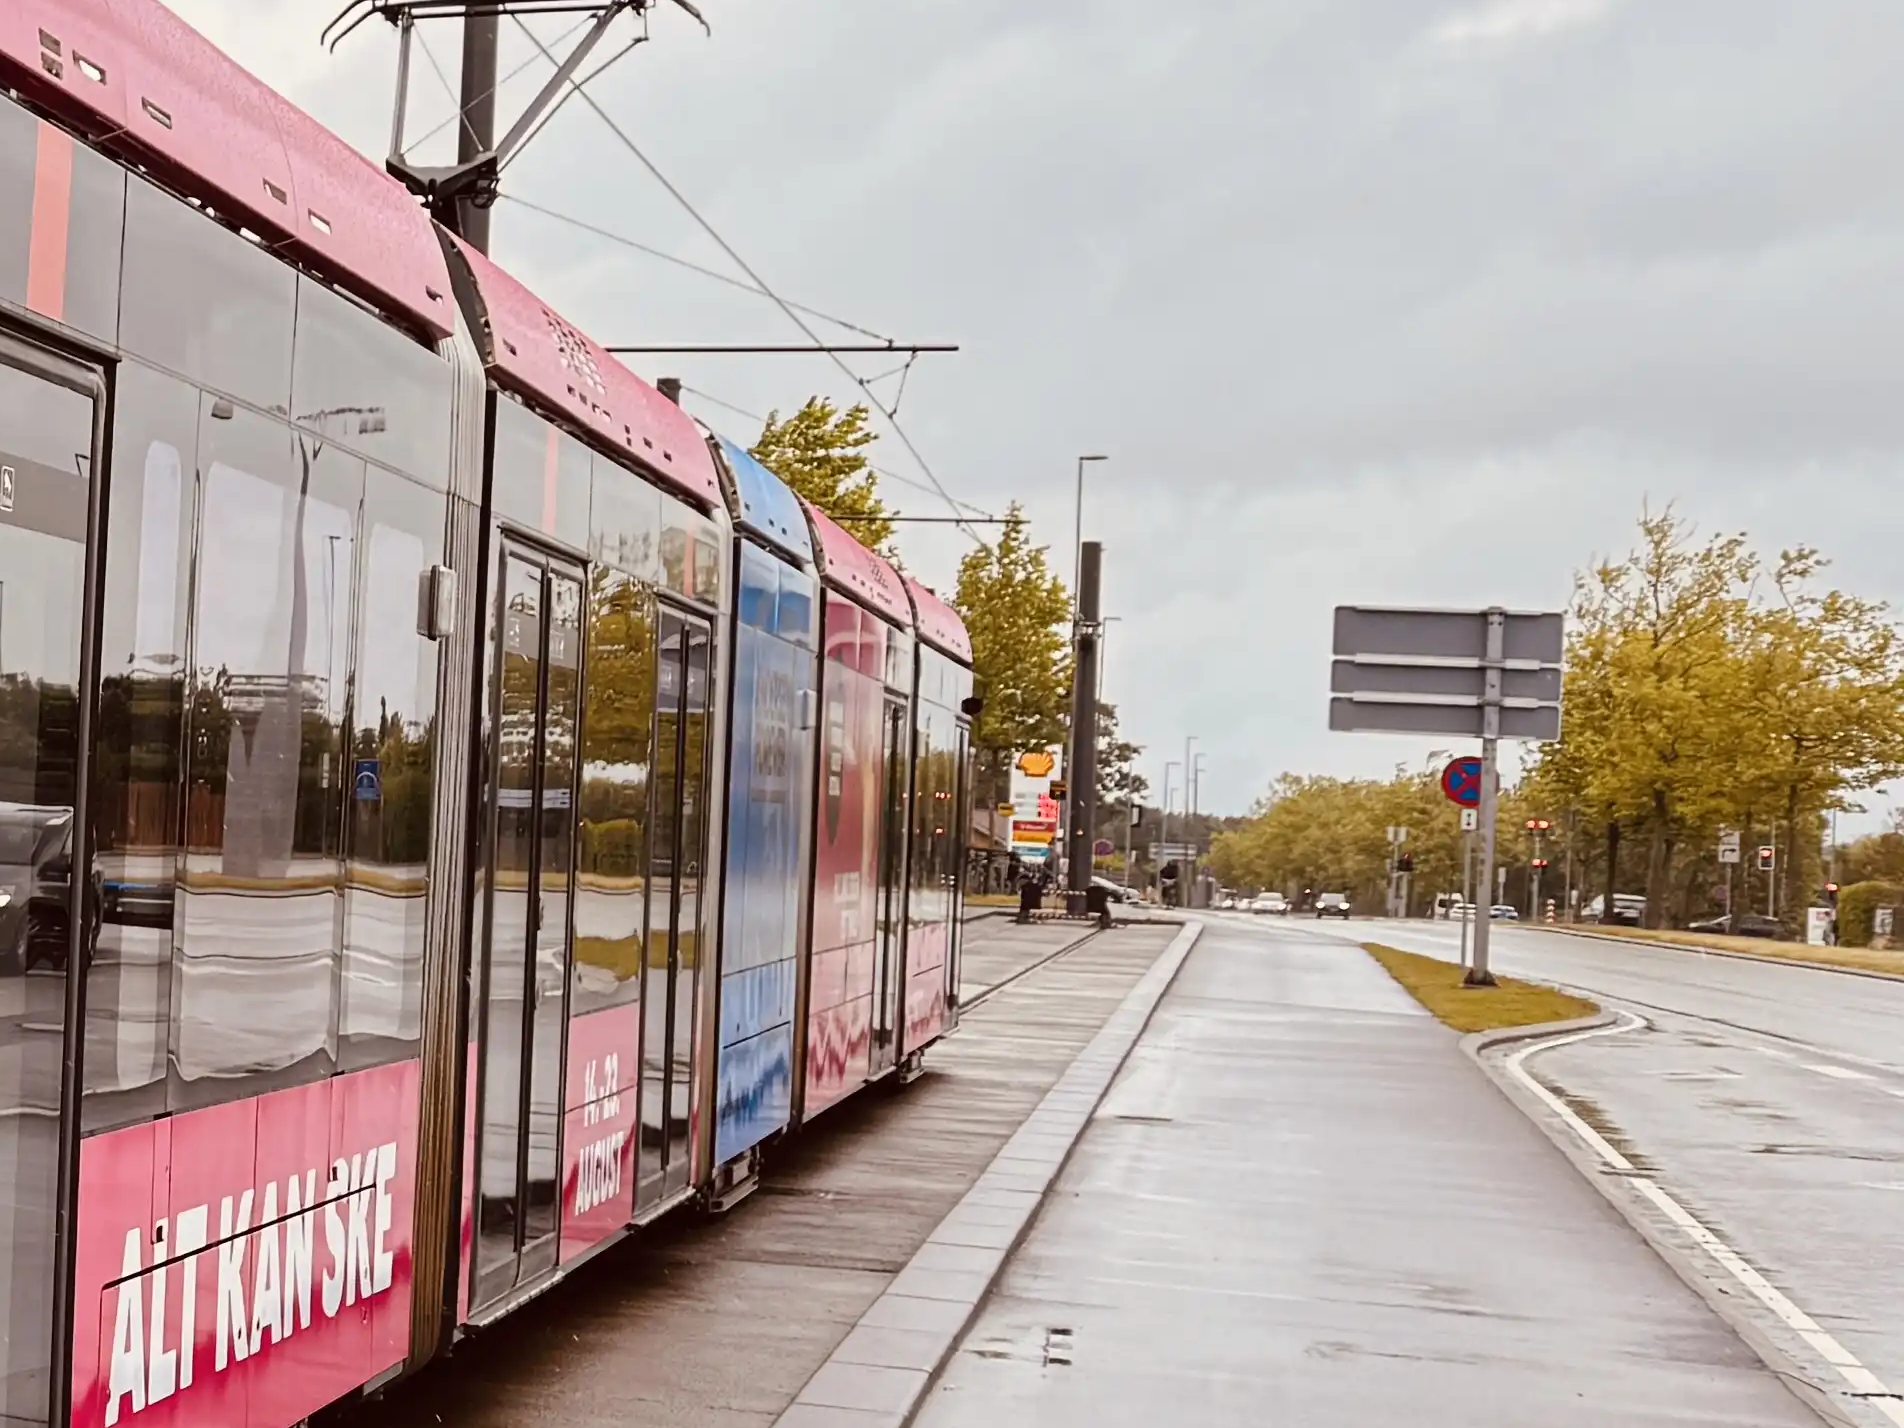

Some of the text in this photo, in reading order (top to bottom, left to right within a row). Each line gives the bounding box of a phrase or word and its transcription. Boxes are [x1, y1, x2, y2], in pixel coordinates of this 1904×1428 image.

[575, 1131, 625, 1217] AUGUST
[104, 1141, 397, 1428] ALT KAN SKE
